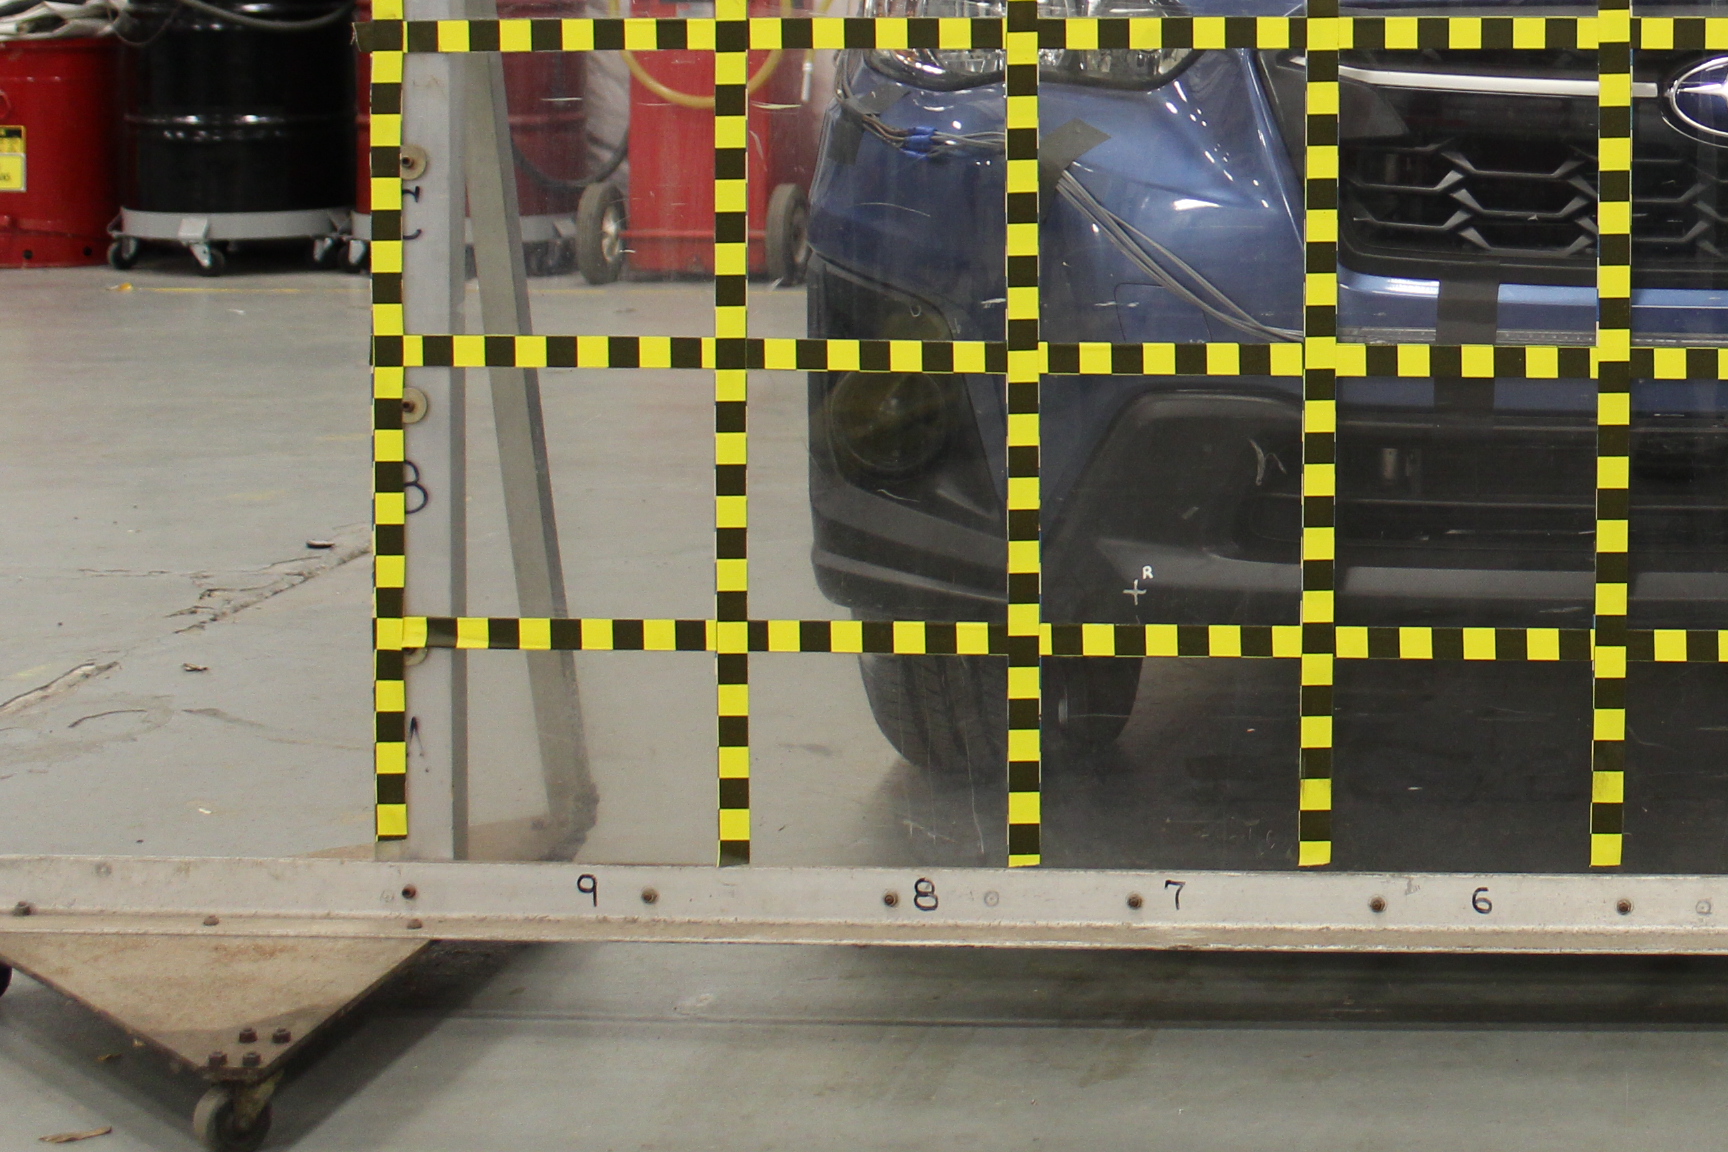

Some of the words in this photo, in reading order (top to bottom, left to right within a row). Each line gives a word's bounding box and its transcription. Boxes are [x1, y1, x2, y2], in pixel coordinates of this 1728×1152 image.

[1142, 565, 1154, 580] R
[576, 873, 598, 908] 9
[913, 877, 939, 912] 8
[1164, 879, 1186, 911] 7
[1471, 886, 1493, 915] 6
